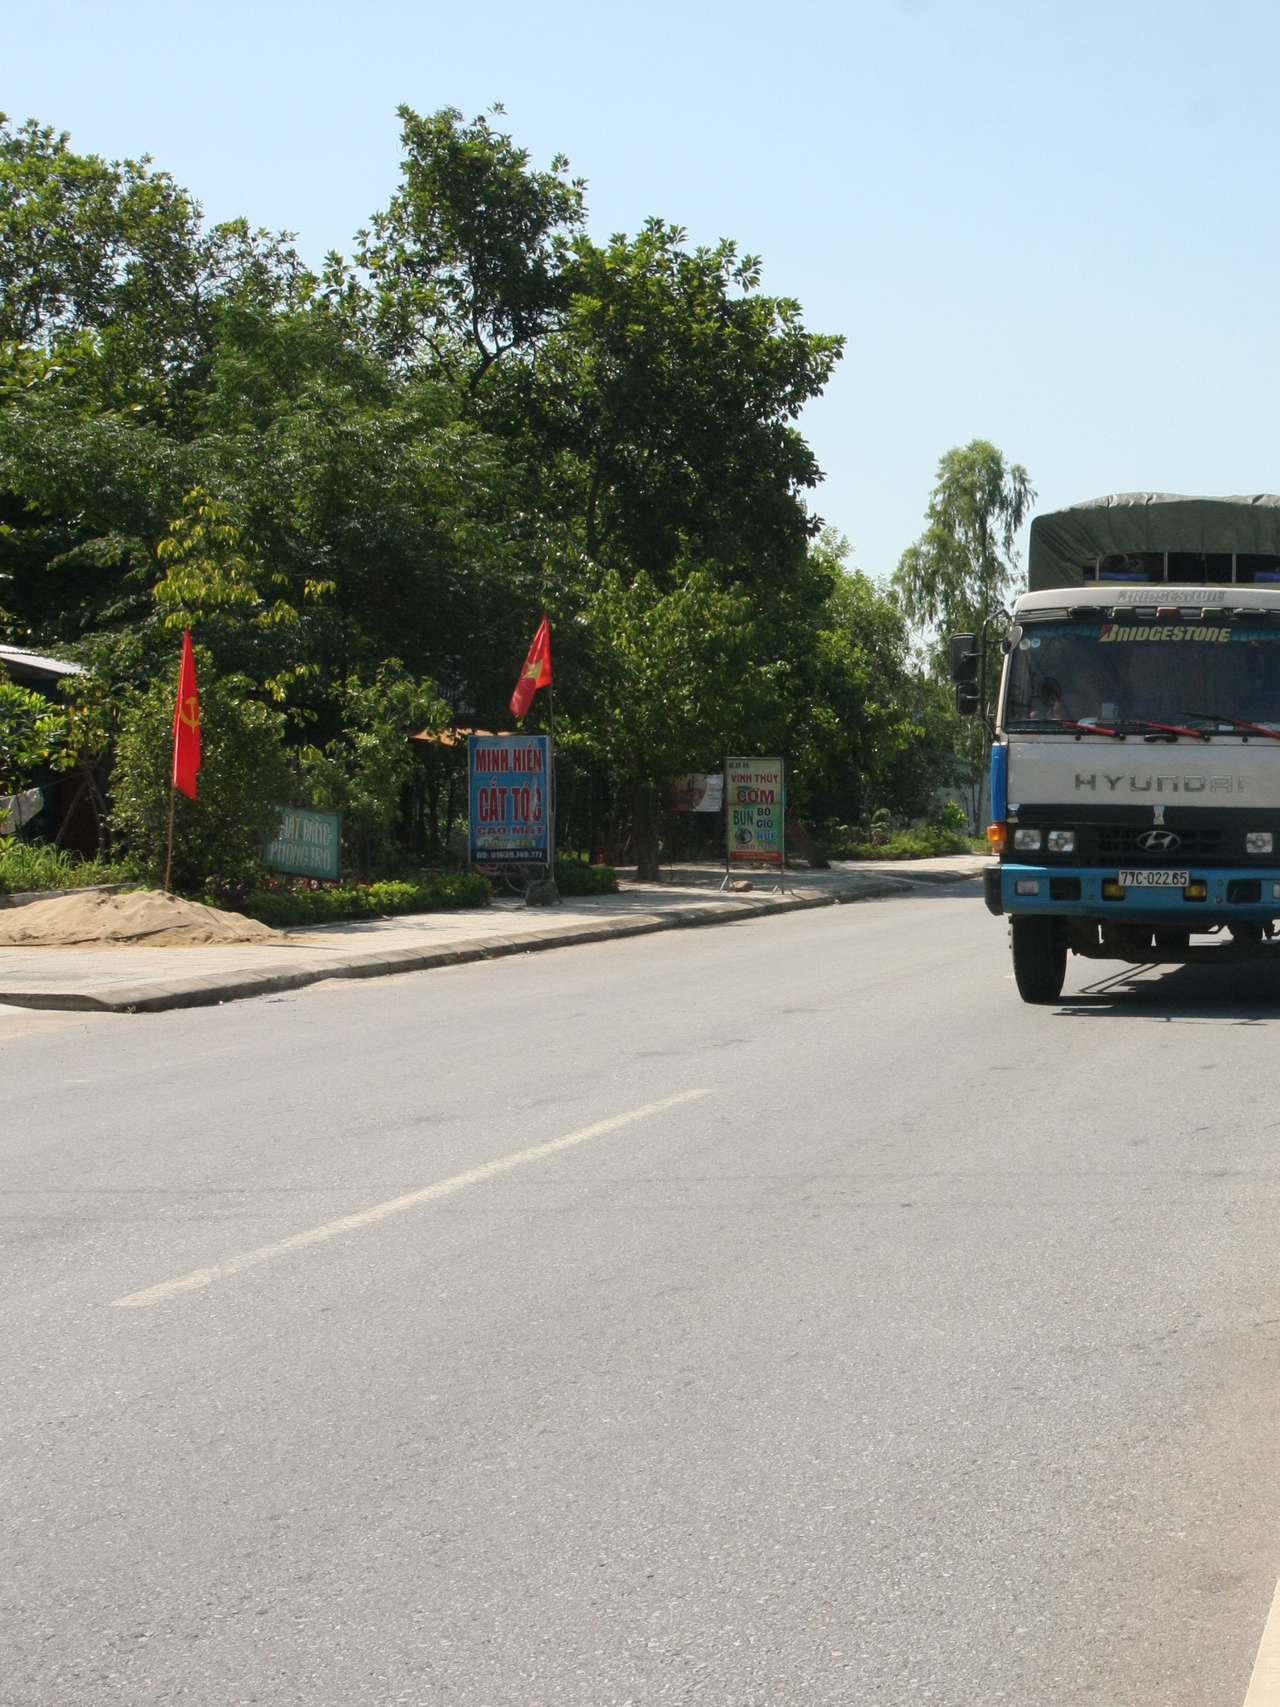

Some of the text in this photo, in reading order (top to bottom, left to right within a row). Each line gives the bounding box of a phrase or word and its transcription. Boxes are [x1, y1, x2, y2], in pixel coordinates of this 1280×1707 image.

[475, 748, 509, 772] MINH
[1074, 774, 1244, 793] HYUNDAI
[479, 777, 542, 822] CẮT TÓC
[736, 788, 775, 803] CƠM
